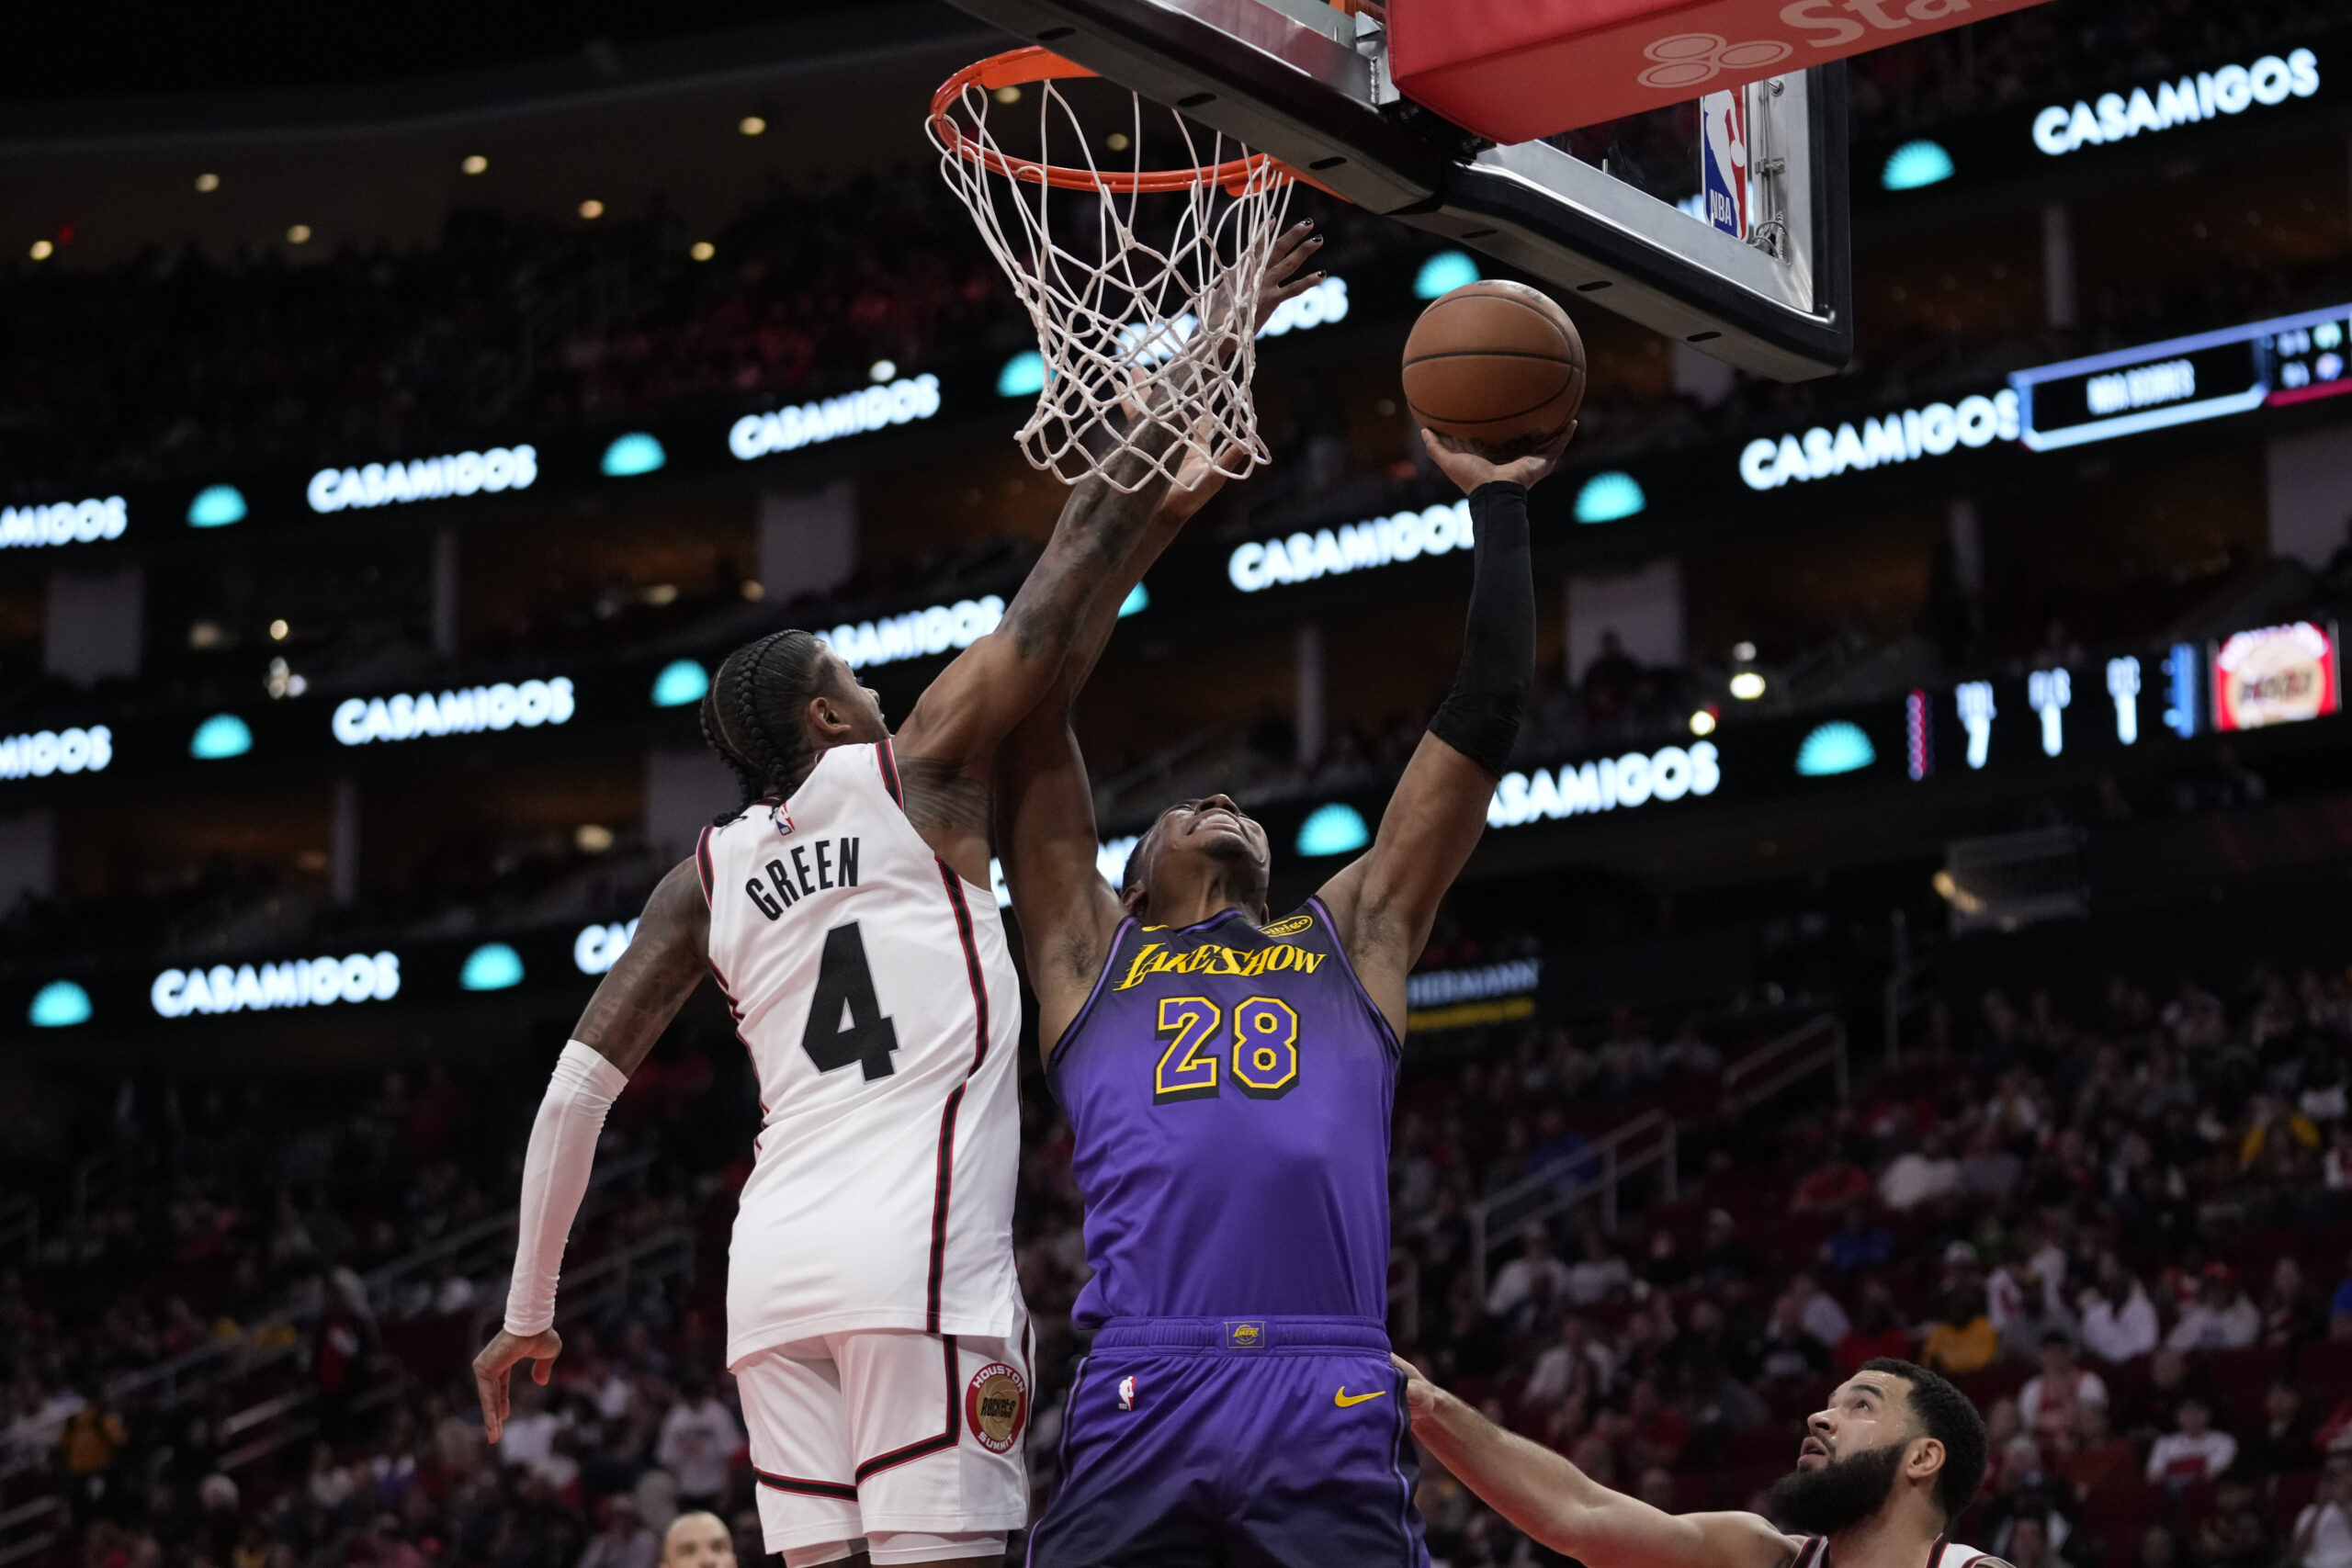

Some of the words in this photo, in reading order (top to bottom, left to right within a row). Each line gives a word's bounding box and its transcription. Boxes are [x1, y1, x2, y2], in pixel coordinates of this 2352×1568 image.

[2033, 49, 2319, 154] CASAMIGOS
[1710, 188, 1733, 227] NBA
[729, 374, 940, 459] CASAMIGOS
[1740, 389, 2020, 491] CASAMIGOS
[308, 445, 537, 513] CASAMIGOS
[333, 677, 574, 745] CASAMIGOS
[745, 837, 860, 921] GREEN
[152, 952, 400, 1017] CASAMIGOS
[1112, 942, 1327, 991] LAKESHOW
[800, 918, 902, 1085] 4
[1153, 995, 1300, 1105] 28
[972, 1365, 1025, 1393] HOUSTON
[978, 1431, 1013, 1450] SUMMIT
